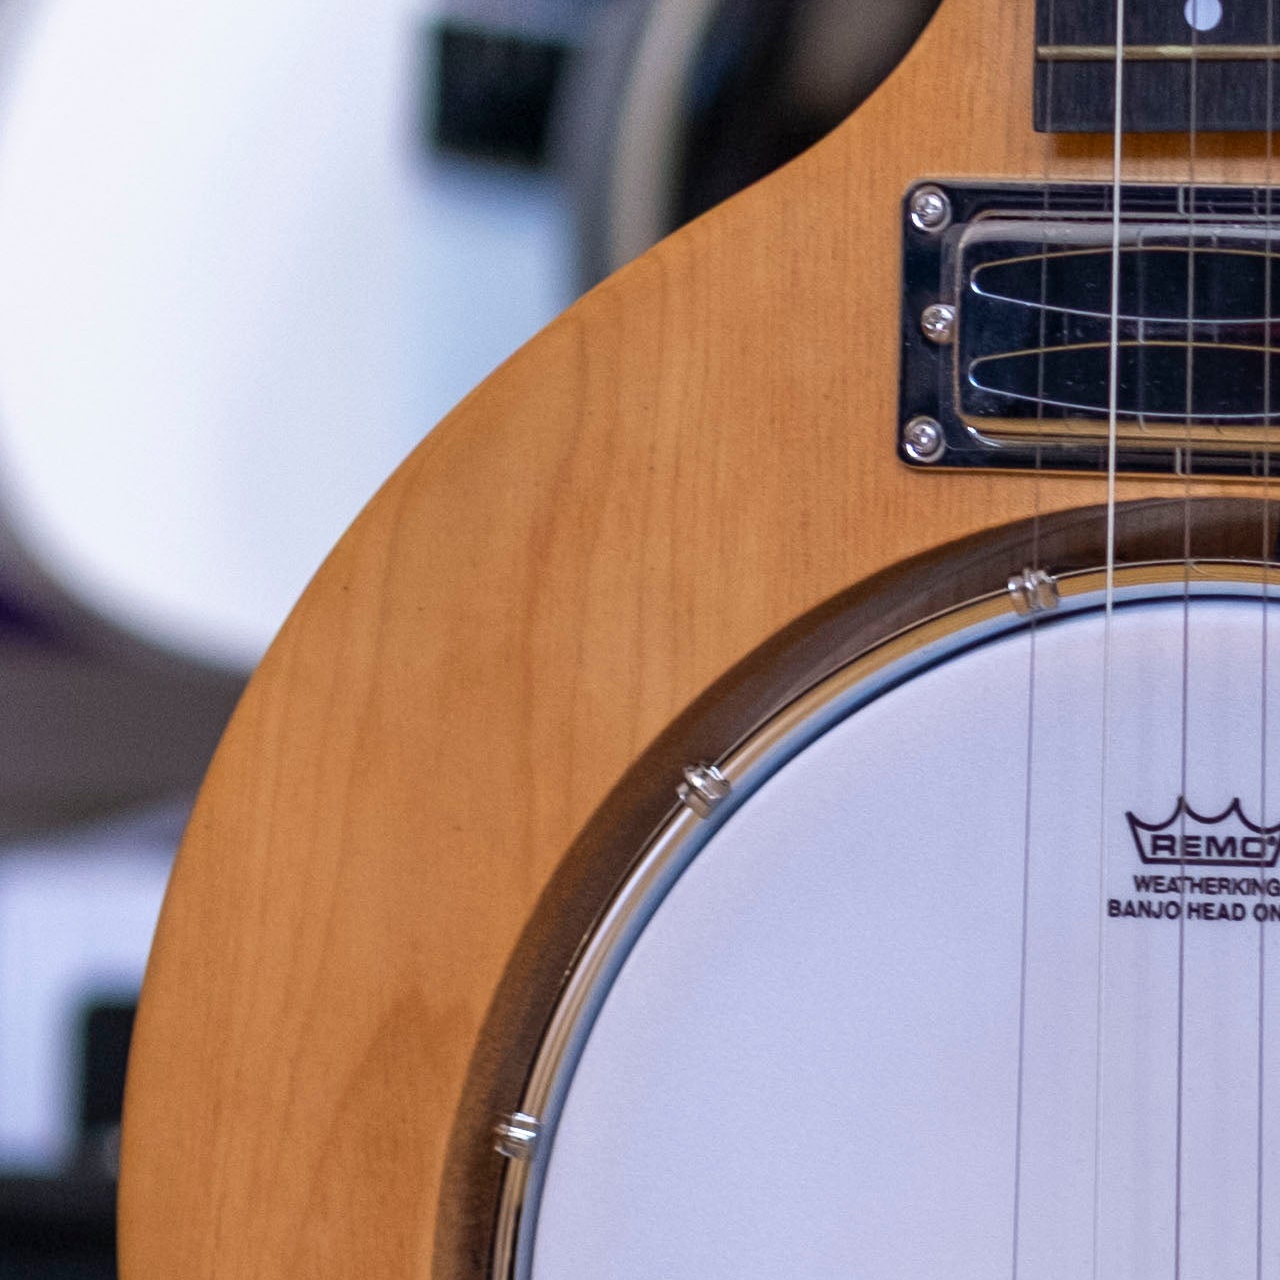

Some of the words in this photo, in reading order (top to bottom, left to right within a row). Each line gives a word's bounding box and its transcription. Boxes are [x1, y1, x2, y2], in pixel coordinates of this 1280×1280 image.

[1151, 834, 1266, 858] REMO
[1107, 899, 1182, 920] BANJO
[1187, 902, 1246, 921] HEAD
